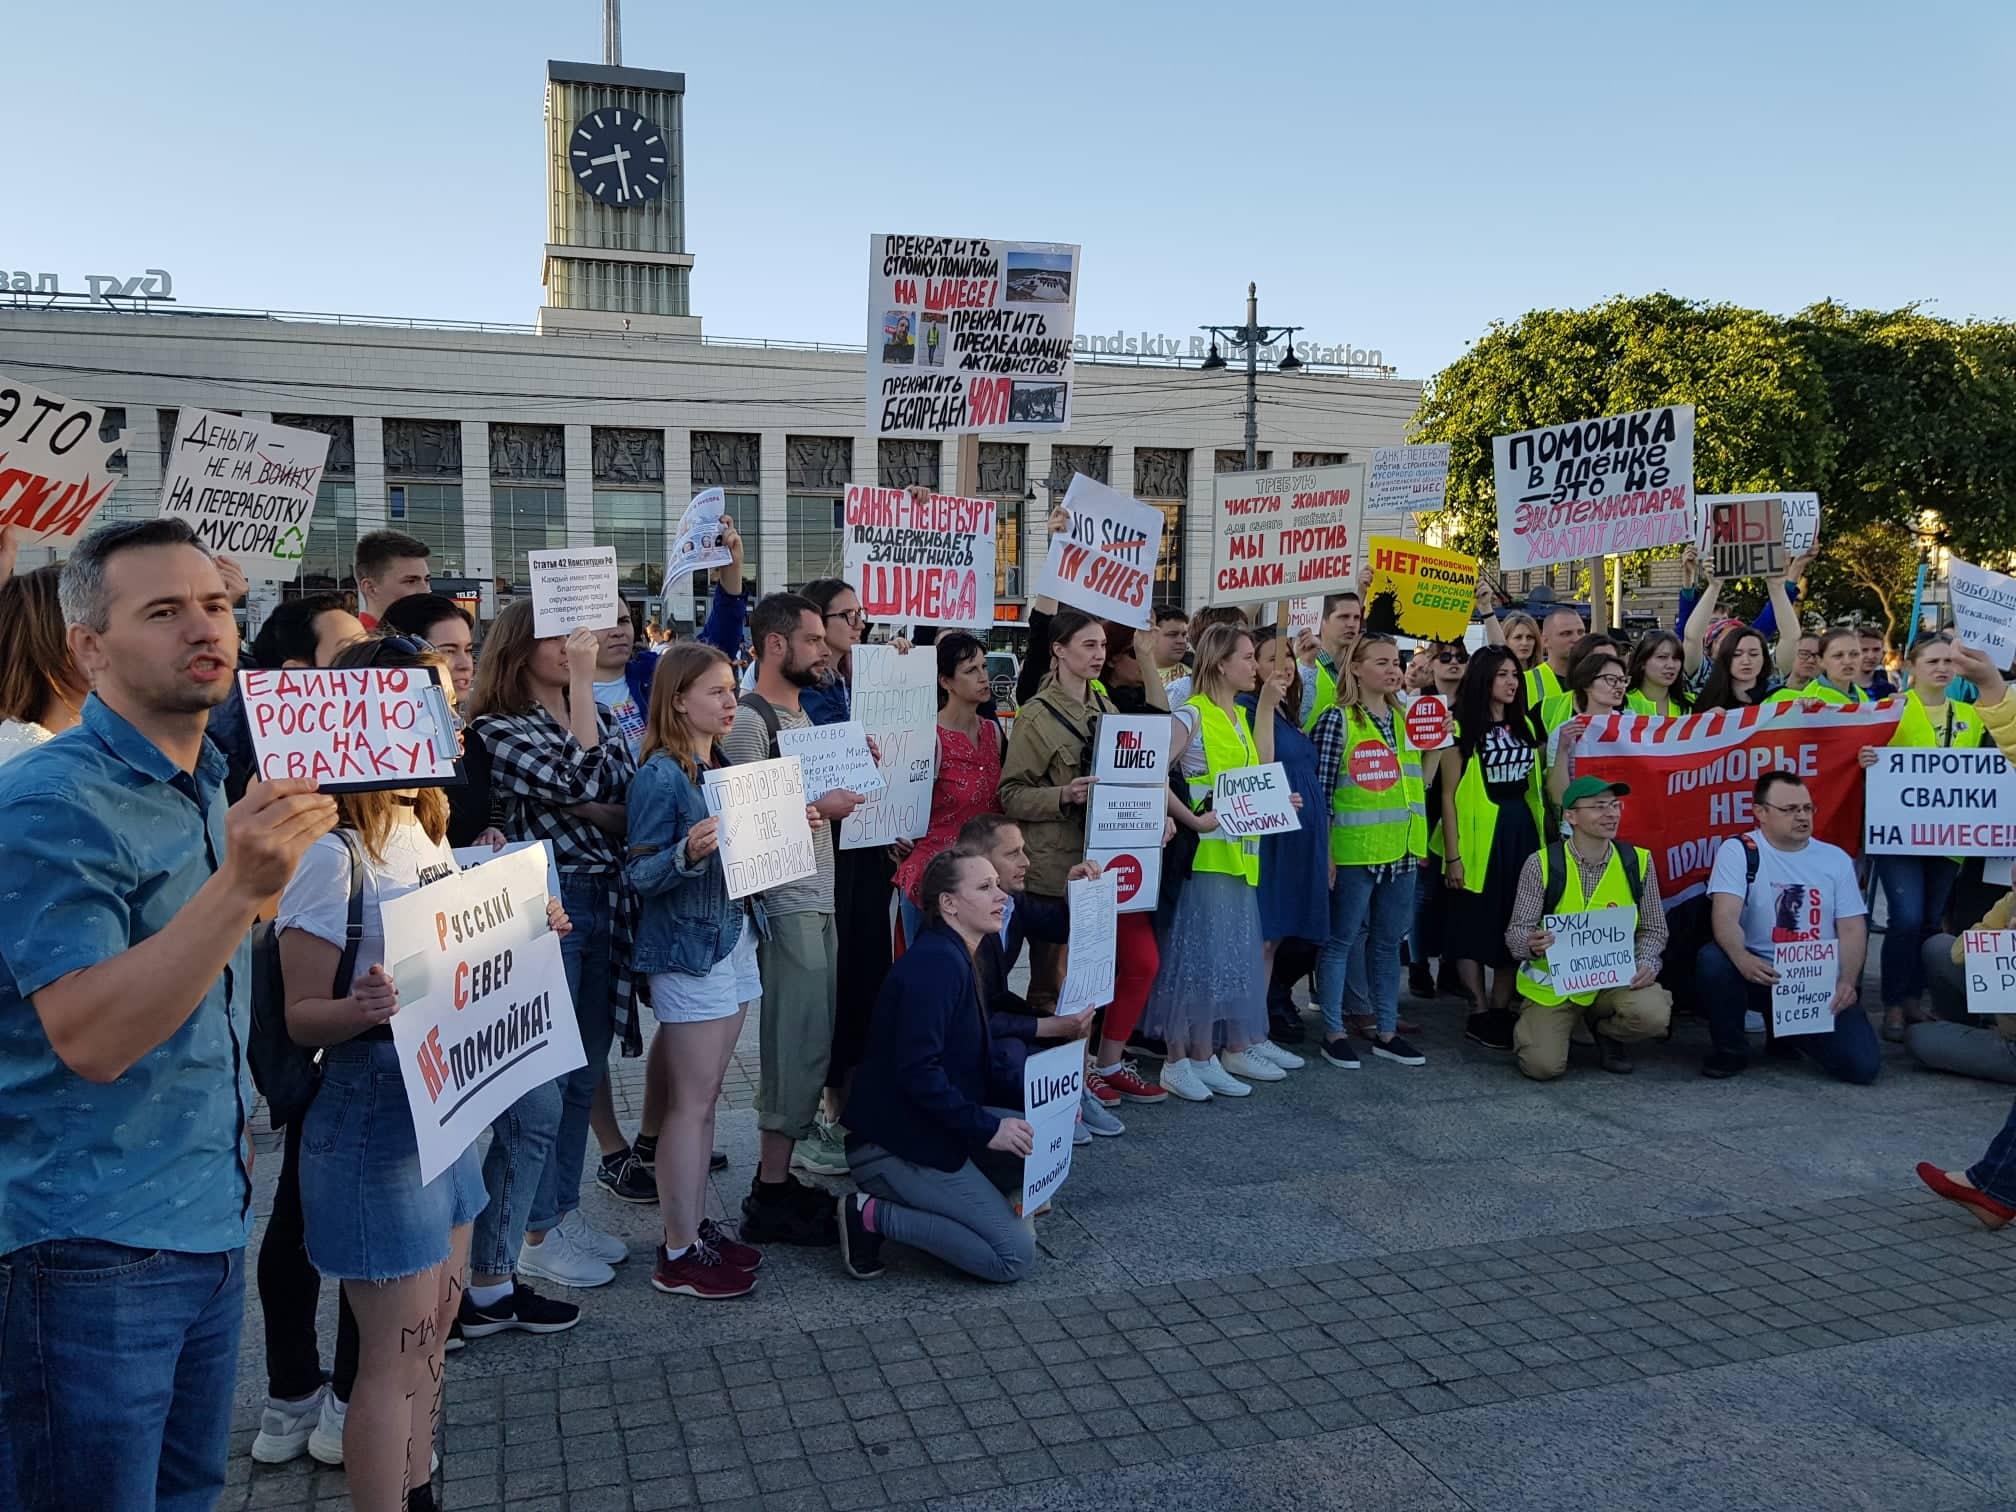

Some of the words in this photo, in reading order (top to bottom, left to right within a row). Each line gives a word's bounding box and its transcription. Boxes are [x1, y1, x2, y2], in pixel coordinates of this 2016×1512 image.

[886, 236, 990, 256] ПРЕКРАТИТЬ
[884, 256, 936, 277] СТРОЙКУ
[937, 257, 998, 278] ПОЛИГОНА
[894, 280, 917, 304] НА
[925, 279, 998, 311] ШИЕСЕ!
[950, 309, 1046, 336] ПРЕКРАТИТЬ
[953, 333, 1072, 360] ПРЕСЛЕДОВАНИЕ
[1296, 341, 1382, 366] Station
[960, 353, 1066, 376] АКТИВИСТОВ!
[882, 375, 963, 396] ПРЕКРАТИТЬ
[881, 395, 966, 432] БЕСПРЕДЕЛ
[968, 377, 1011, 427] ЧОП
[0, 388, 92, 455] ЭТО
[1510, 409, 1676, 470] ПОМОЙКА
[204, 456, 229, 478] НЕ
[231, 459, 250, 481] НА
[259, 458, 316, 490] ВОЙНУ
[1256, 475, 1316, 494] ТРЕБУЮ
[166, 475, 194, 511] НА
[195, 487, 308, 524] ПЕРЕРАБОТКУ
[846, 487, 995, 535] САНКТ-ПЕТЕРБУРГ
[1225, 496, 1281, 516] ЧИСТУЮ
[1291, 489, 1350, 509] ЭКОЛОГИЮ
[197, 519, 278, 553] МУСОРА
[854, 525, 976, 552] ПОДДЕРЖИВАЕТ
[1071, 511, 1094, 546] NO
[1101, 518, 1147, 565] SHIT
[1229, 534, 1264, 560] МЫ
[1280, 525, 1347, 555] ПРОТИВ
[1526, 525, 1607, 563] ХВАТИТ
[1612, 511, 1690, 549] ВРАТЬ!
[534, 561, 557, 569] Статья
[559, 559, 567, 567] 42
[867, 545, 974, 567] ЗАЩИТНИКОВ
[1376, 548, 1419, 575] НЕТ
[1422, 556, 1473, 572] МОСКОВСКИМ
[1713, 542, 1783, 577] ШИЕС
[1058, 543, 1090, 582] IN
[1084, 556, 1149, 607] SHIES
[1217, 563, 1283, 591] СВАЛКИ
[1298, 555, 1352, 581] ШИЕСЕ
[1421, 567, 1474, 585] ОТХОДАМ
[862, 564, 976, 620] ШИЕСА
[1413, 592, 1470, 613] СЕВЕРЕ
[1417, 582, 1429, 591] НА
[1432, 584, 1472, 598] РУССКОМ
[246, 669, 409, 700] ЕДИНУЮ
[1416, 703, 1435, 715] НЕТ!
[333, 731, 371, 753] НА
[783, 728, 846, 746] СКОЛКОВО
[263, 738, 436, 780] СВАЛКУ!
[910, 759, 930, 771] СТОП
[1114, 750, 1156, 769] ШИЕС
[1667, 744, 1818, 795] ПОМОРЬЕ
[1890, 754, 1903, 773] Я
[1912, 754, 2007, 774] ПРОТИВ
[709, 763, 803, 811] ПОМОРЬЕ
[910, 770, 929, 783] ШИЕС
[1217, 773, 1275, 799] ПОМОРЬЕ
[1231, 794, 1257, 818] НЕ
[1710, 790, 1754, 825] НЕ
[1901, 788, 1997, 808] СВАЛКИ
[754, 810, 781, 840] НЕ
[848, 798, 919, 843] ЗЕМЛЮ!
[1221, 812, 1289, 834] ПОМОЙКА
[1869, 825, 1903, 845] НА
[728, 836, 817, 893] ПОМОЙКА
[436, 888, 514, 951] РУССКИЙ
[1545, 913, 1589, 932] РУКИ
[1571, 927, 1625, 948] ПРОЧЬ
[1965, 932, 2000, 953] НЕТ
[1777, 944, 1833, 964] МОСКВА
[453, 949, 513, 1011] СЕВЕР
[1786, 966, 1822, 978] ХРАНИ
[1973, 975, 1988, 992] В
[1776, 982, 1805, 995] СВОЙ
[1797, 992, 1831, 1005] МУСОР
[417, 1024, 450, 1104] НЕ
[449, 991, 553, 1091] ПОМОЙКА!
[1031, 1071, 1079, 1109] Шиес
[1050, 1137, 1062, 1152] не
[1028, 1152, 1070, 1199] помойка!
